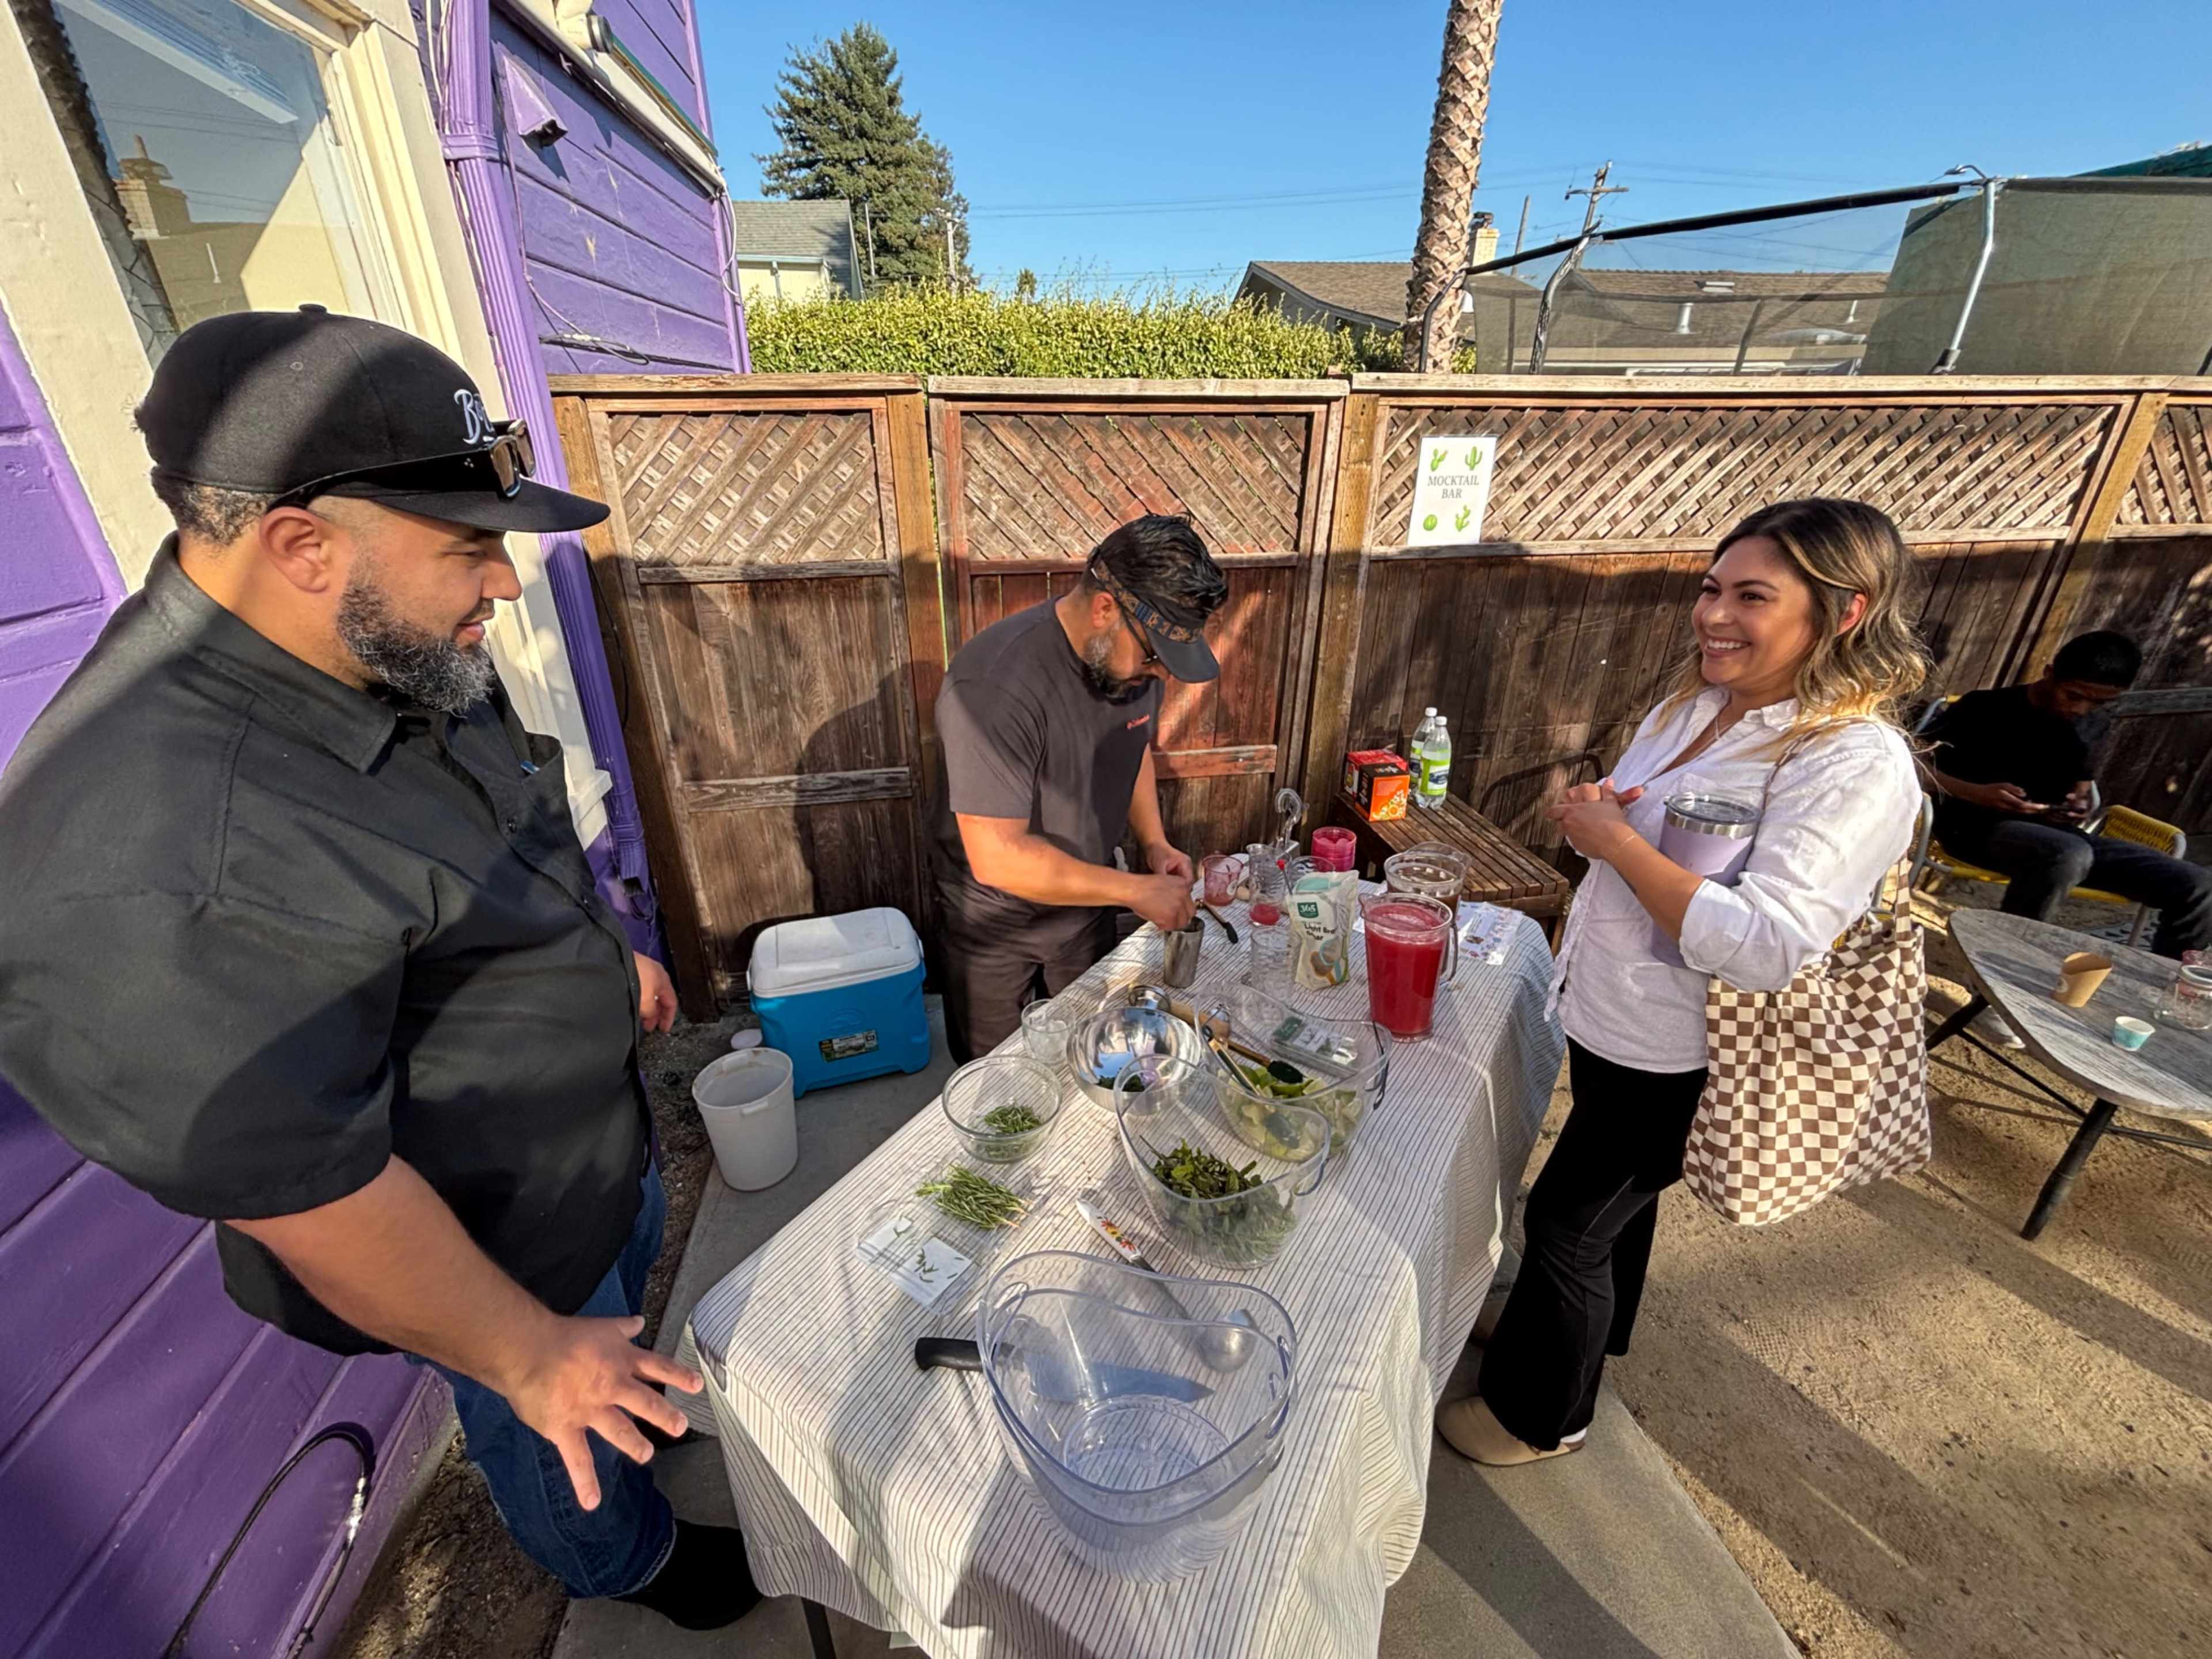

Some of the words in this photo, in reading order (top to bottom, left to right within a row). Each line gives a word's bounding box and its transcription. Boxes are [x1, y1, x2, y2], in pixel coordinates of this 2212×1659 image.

[1427, 475, 1479, 486] MOCKTAIL
[1441, 488, 1462, 499] BAR
[1300, 904, 1316, 912] 365
[1304, 922, 1321, 933] Light
